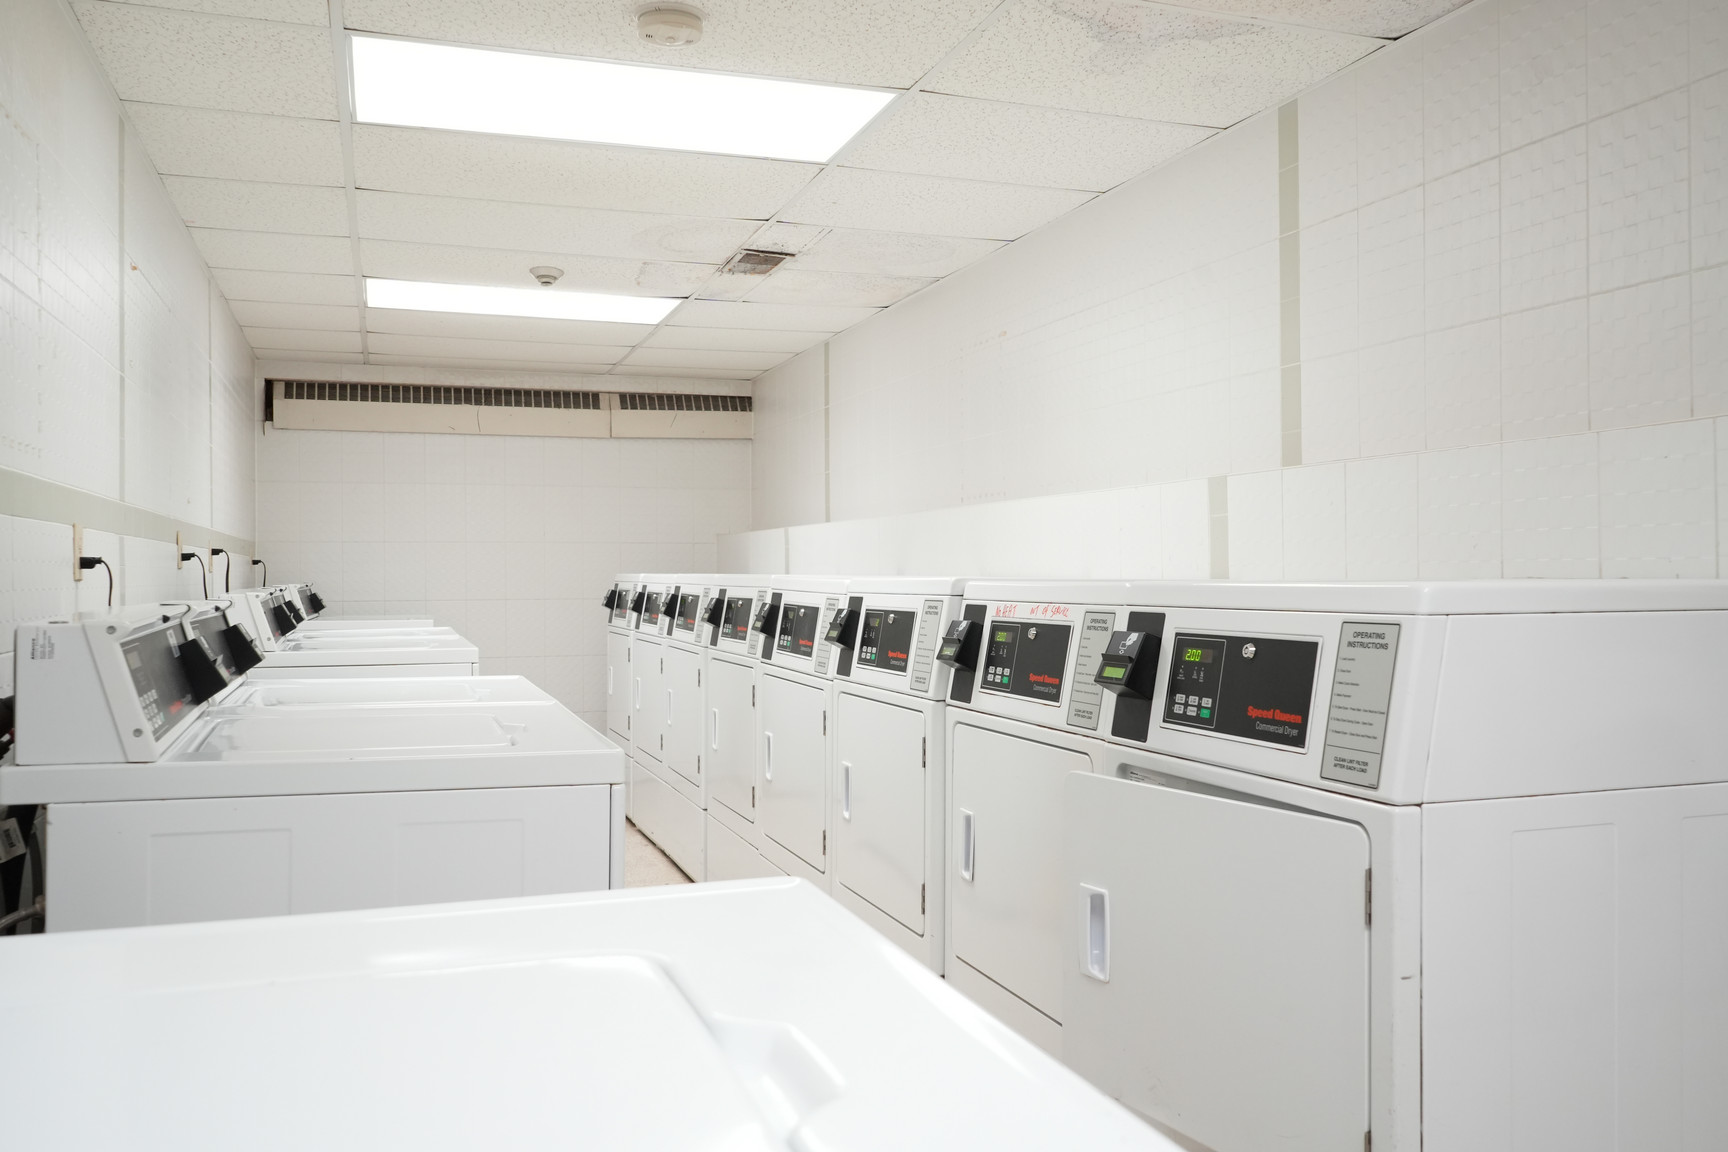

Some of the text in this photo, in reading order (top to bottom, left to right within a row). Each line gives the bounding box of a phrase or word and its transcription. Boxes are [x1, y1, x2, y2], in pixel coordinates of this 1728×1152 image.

[1353, 631, 1386, 640] OPERATING
[1346, 640, 1388, 650] INSTRUCTIONS
[1248, 705, 1302, 724] Speed Queen
[1256, 720, 1299, 737] Commercial Dryer
